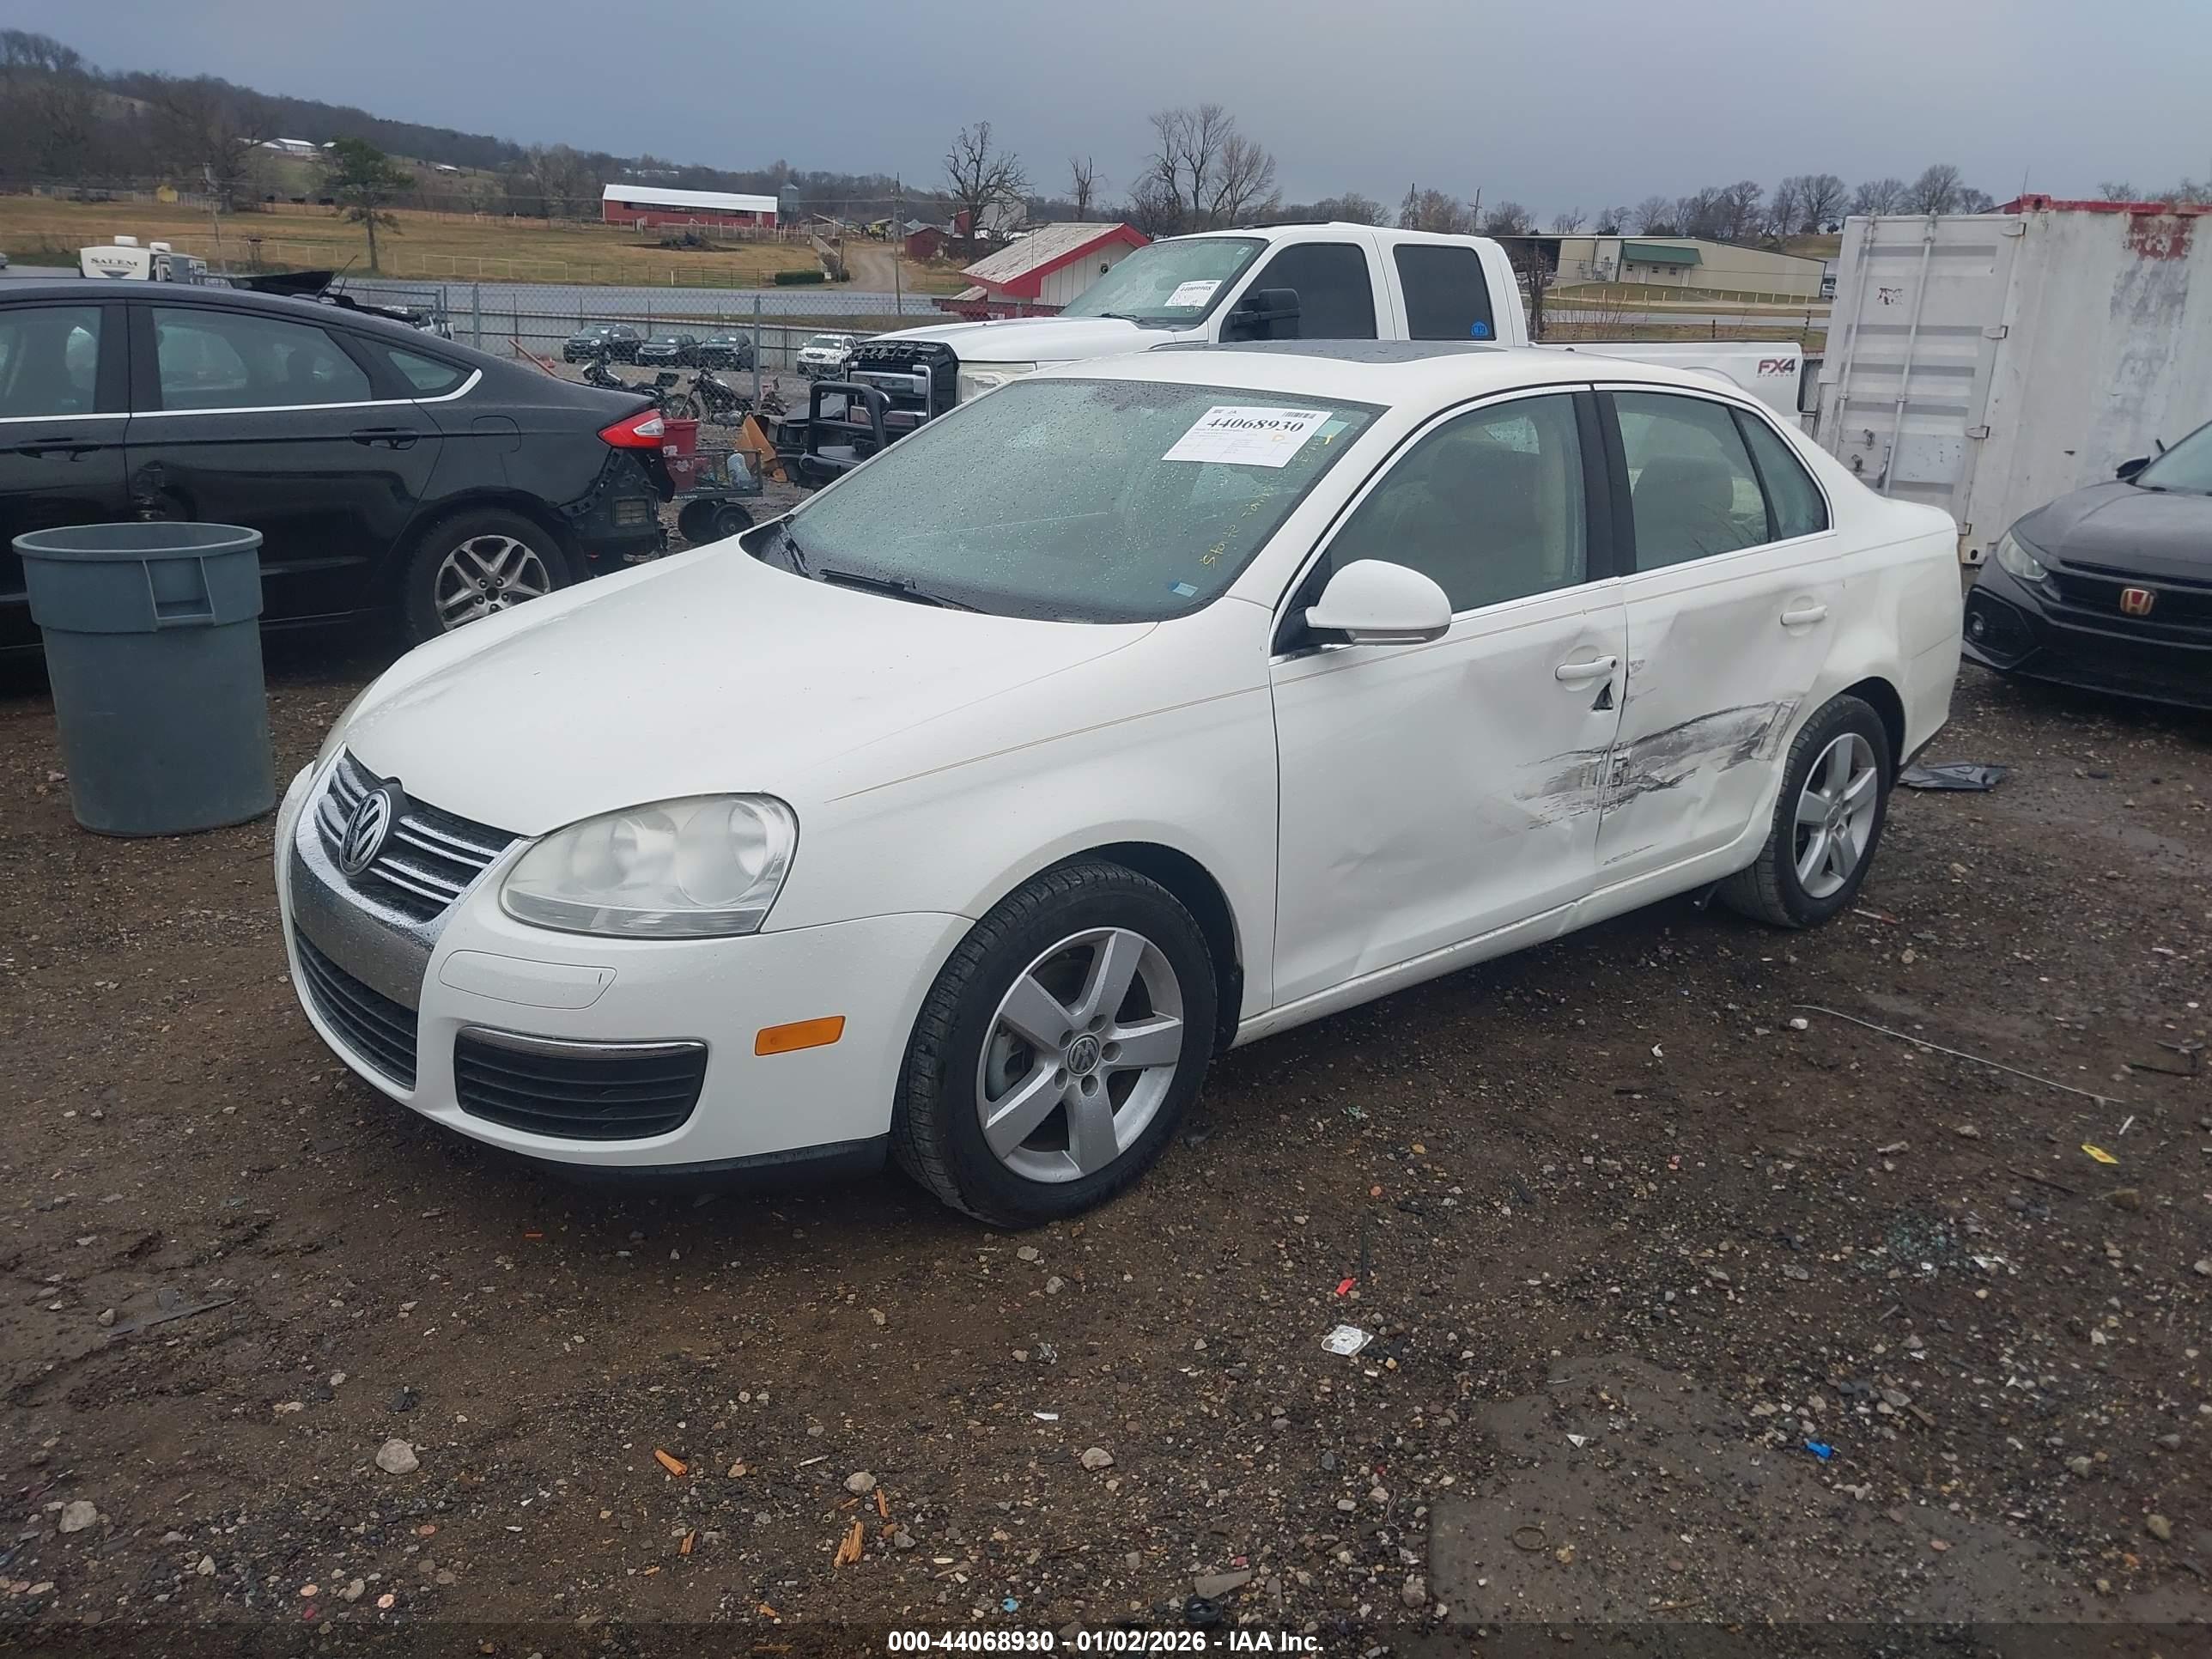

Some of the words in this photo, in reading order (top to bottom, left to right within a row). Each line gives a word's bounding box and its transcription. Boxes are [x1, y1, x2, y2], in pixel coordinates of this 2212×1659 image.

[89, 257, 138, 267] SALEM
[1758, 358, 1796, 374] FX4
[1206, 417, 1304, 433] 44068930
